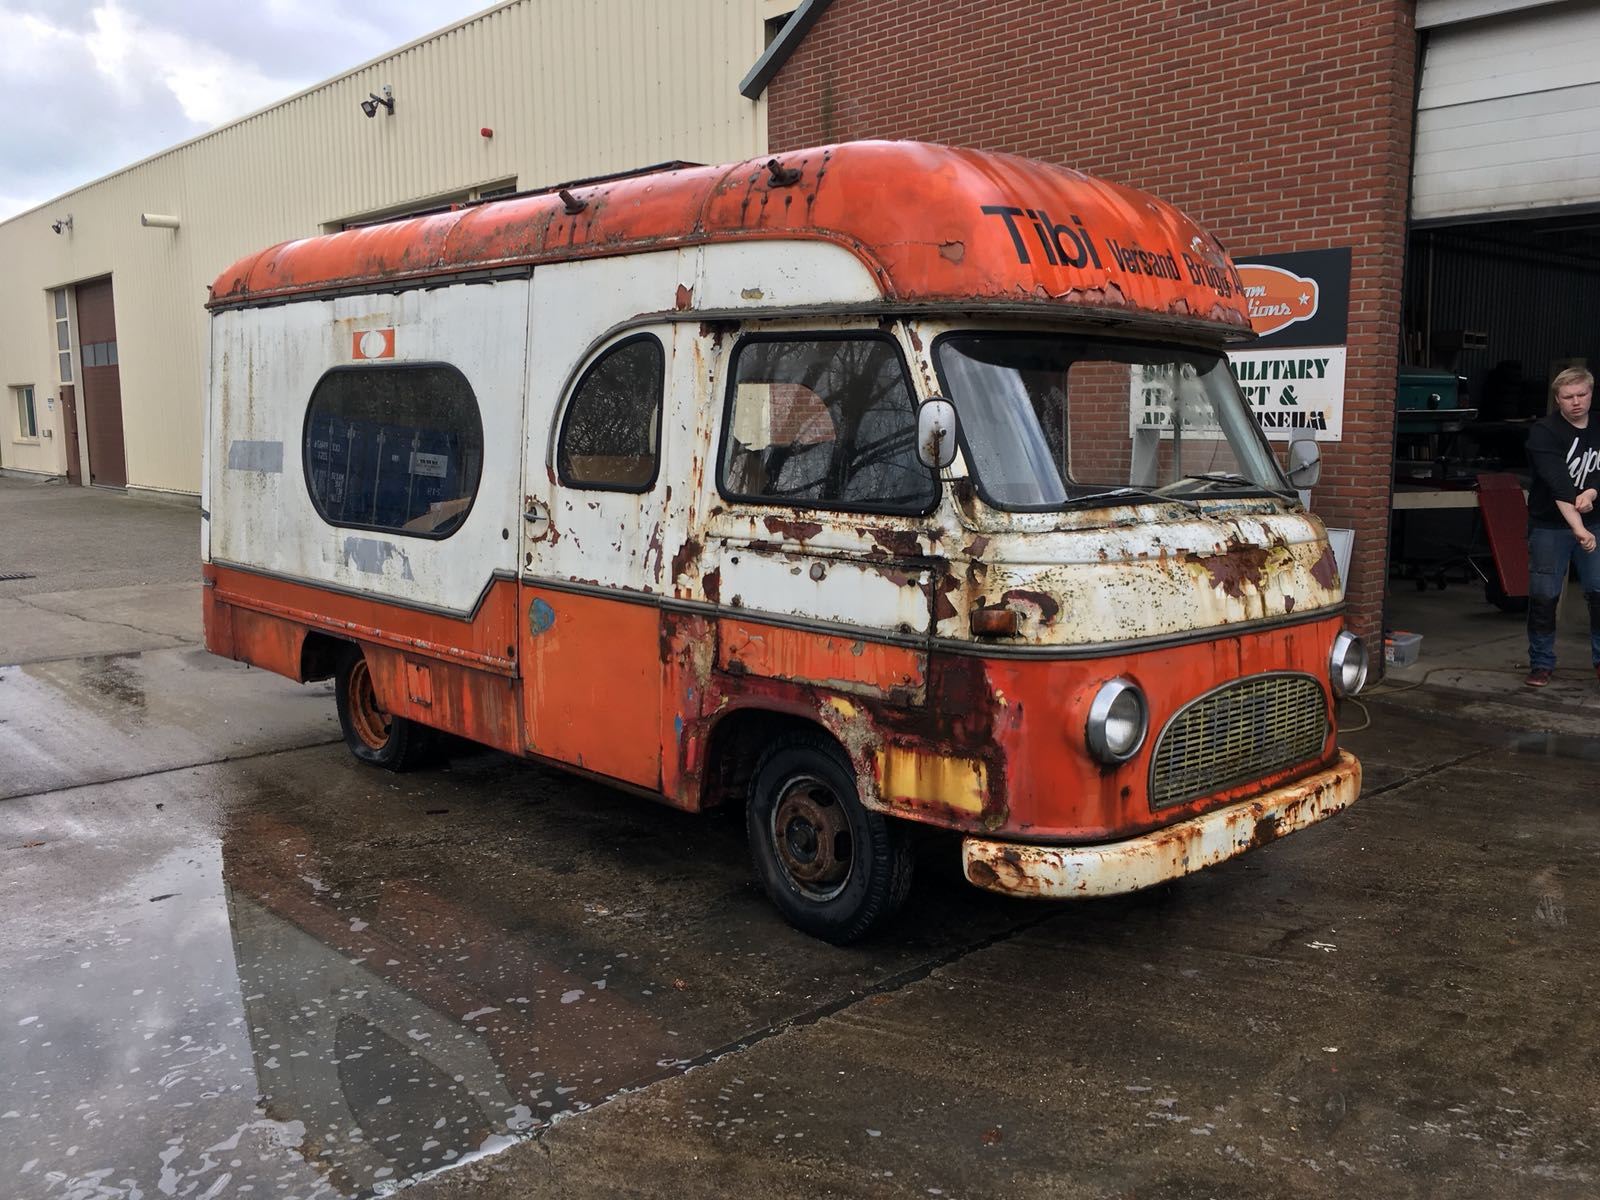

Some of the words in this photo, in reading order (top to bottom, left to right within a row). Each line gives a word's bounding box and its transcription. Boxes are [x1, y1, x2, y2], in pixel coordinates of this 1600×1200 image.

[980, 205, 1102, 269] Tibi
[1105, 238, 1181, 281] Versand
[1248, 299, 1291, 317] tions
[1279, 385, 1298, 405] &
[1254, 411, 1327, 430] USEUM
